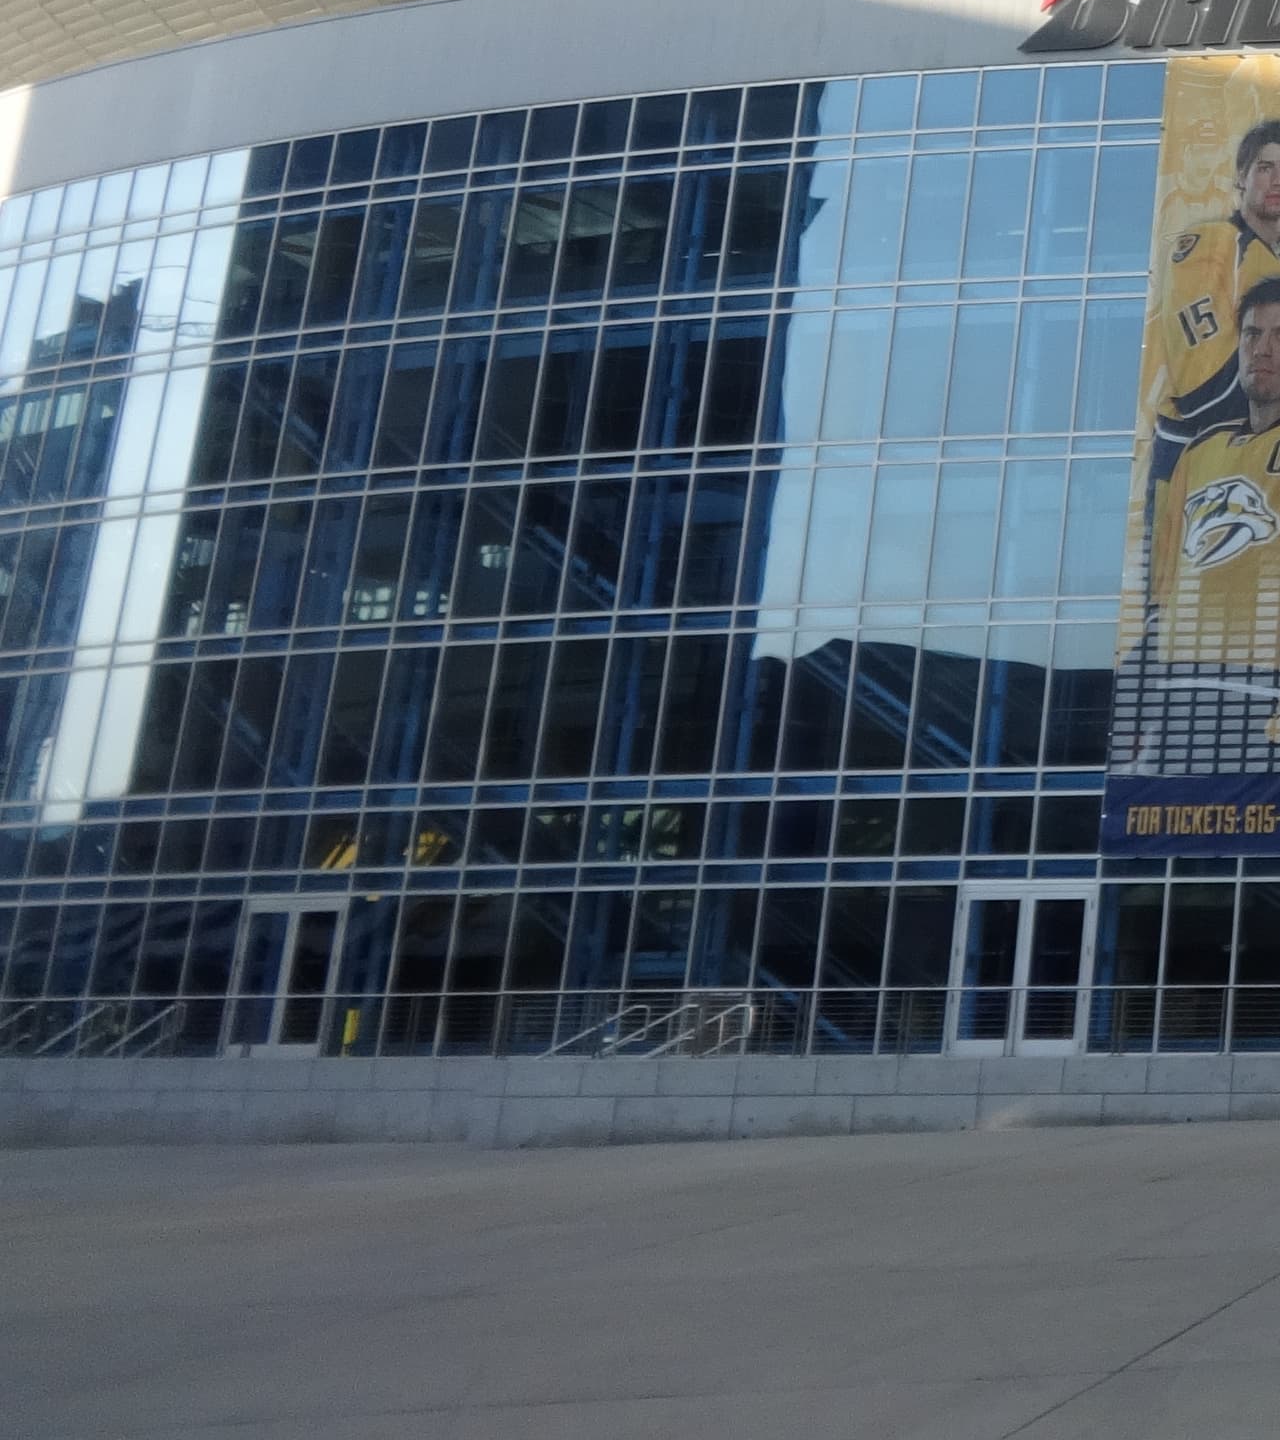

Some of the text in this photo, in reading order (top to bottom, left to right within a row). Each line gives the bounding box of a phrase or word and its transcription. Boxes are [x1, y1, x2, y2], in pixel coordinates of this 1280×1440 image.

[1177, 295, 1219, 348] 15
[1126, 805, 1163, 836] FOR
[1165, 804, 1242, 836] TICKETS:
